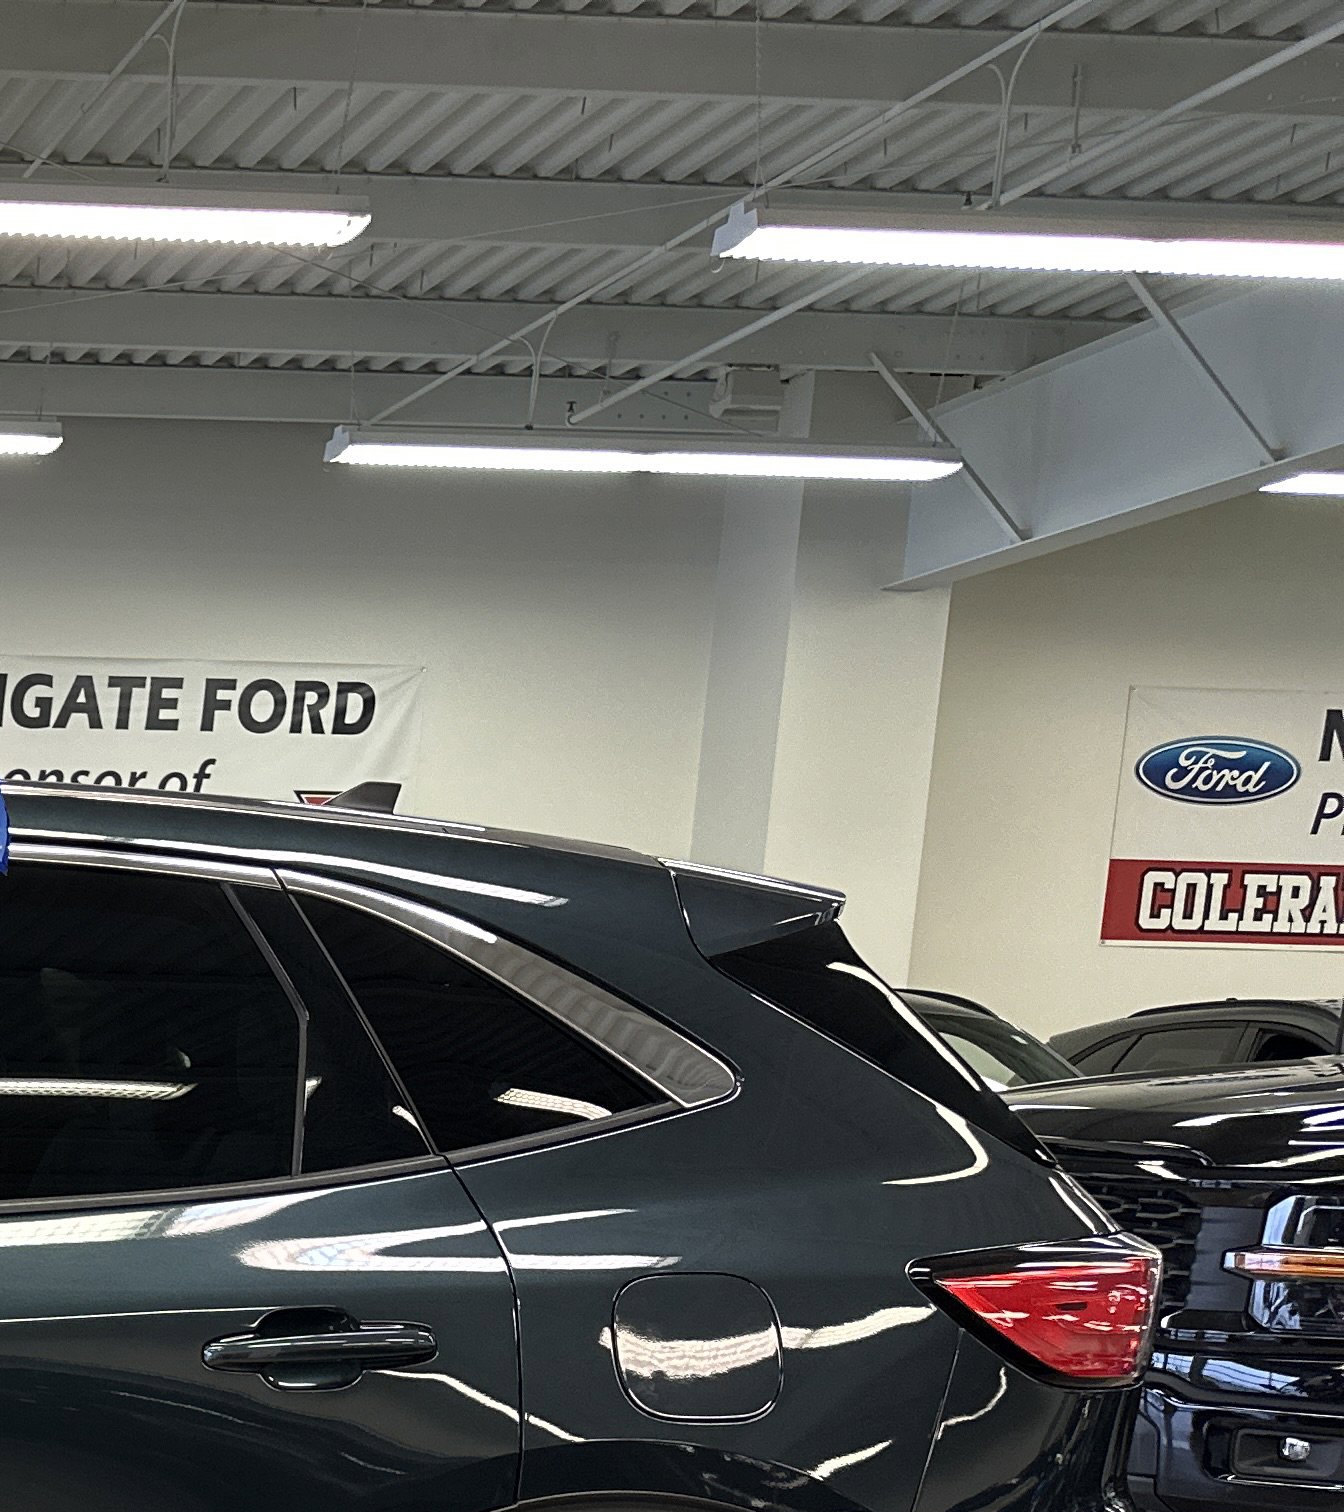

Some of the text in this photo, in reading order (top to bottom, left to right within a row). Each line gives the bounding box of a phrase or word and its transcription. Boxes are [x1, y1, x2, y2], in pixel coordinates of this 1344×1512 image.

[200, 677, 376, 735] FORD
[1164, 746, 1272, 793] Ford
[1138, 868, 1344, 935] COLERA
